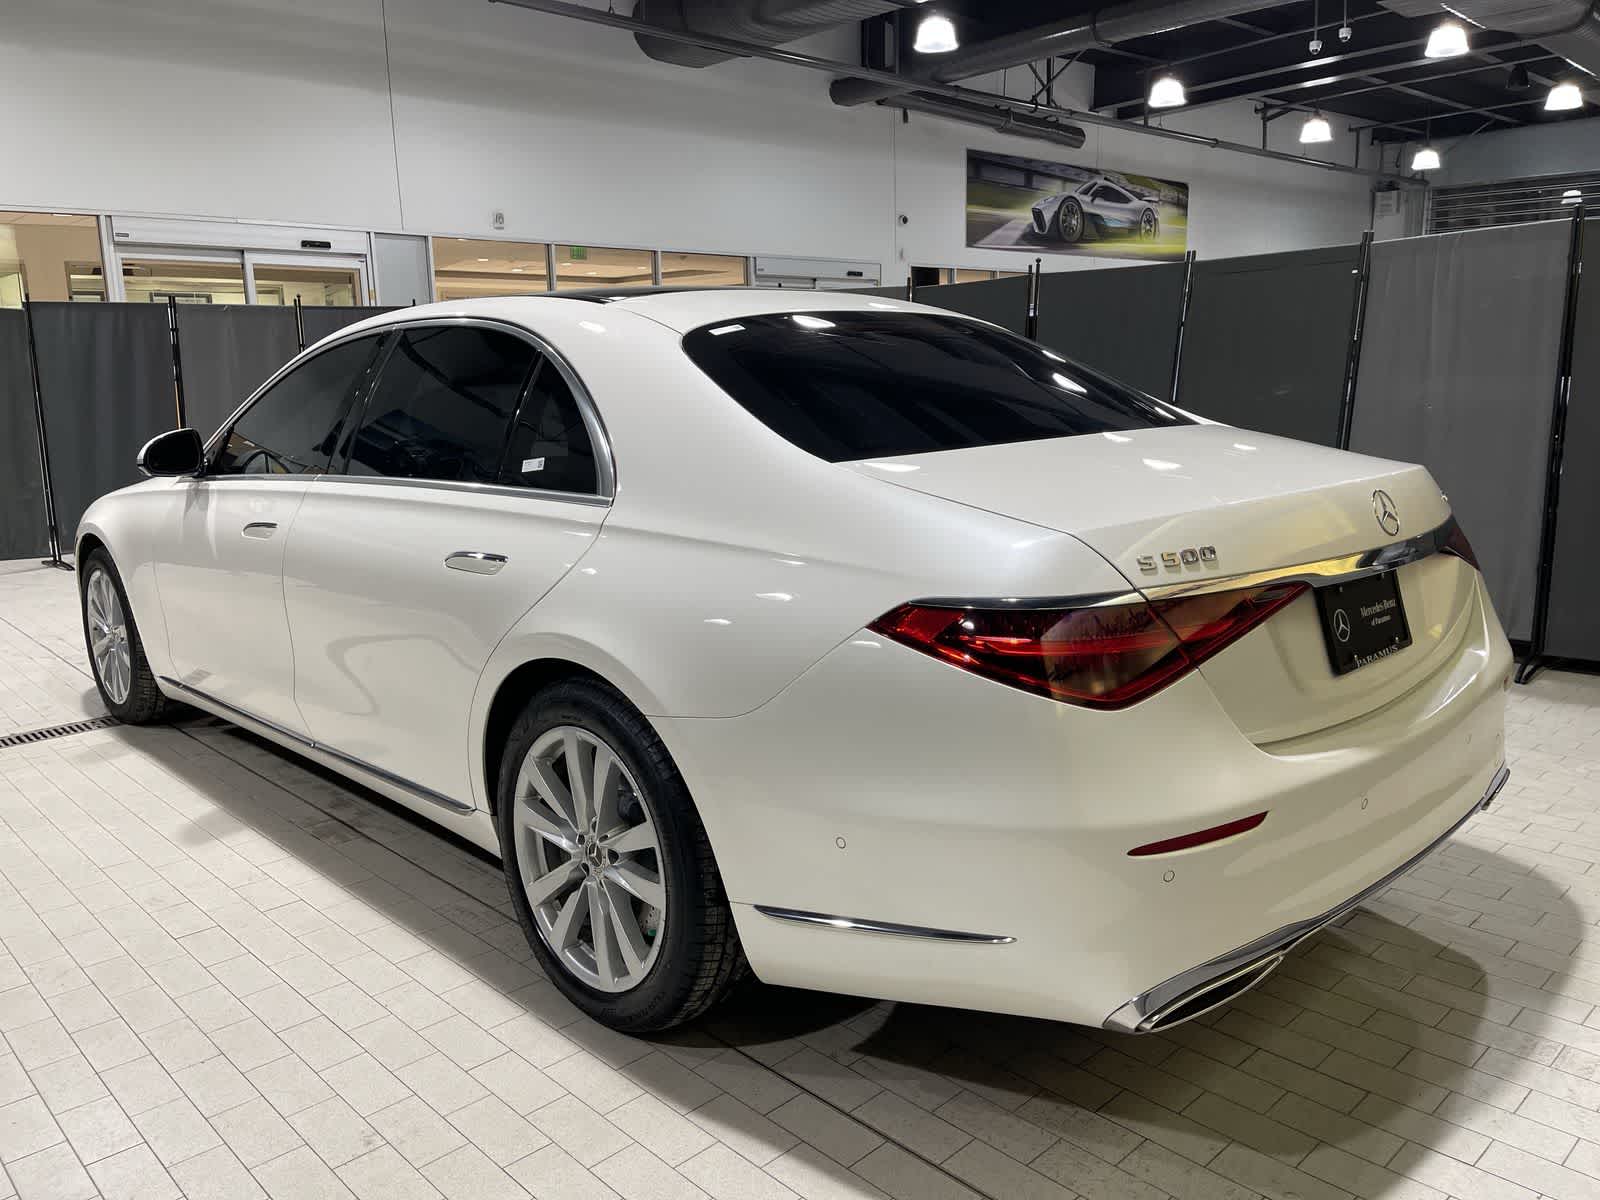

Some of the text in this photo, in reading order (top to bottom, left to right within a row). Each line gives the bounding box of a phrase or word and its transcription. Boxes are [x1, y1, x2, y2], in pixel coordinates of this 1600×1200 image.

[1137, 545, 1218, 572] S 500
[1356, 644, 1399, 669] PARAMUS
